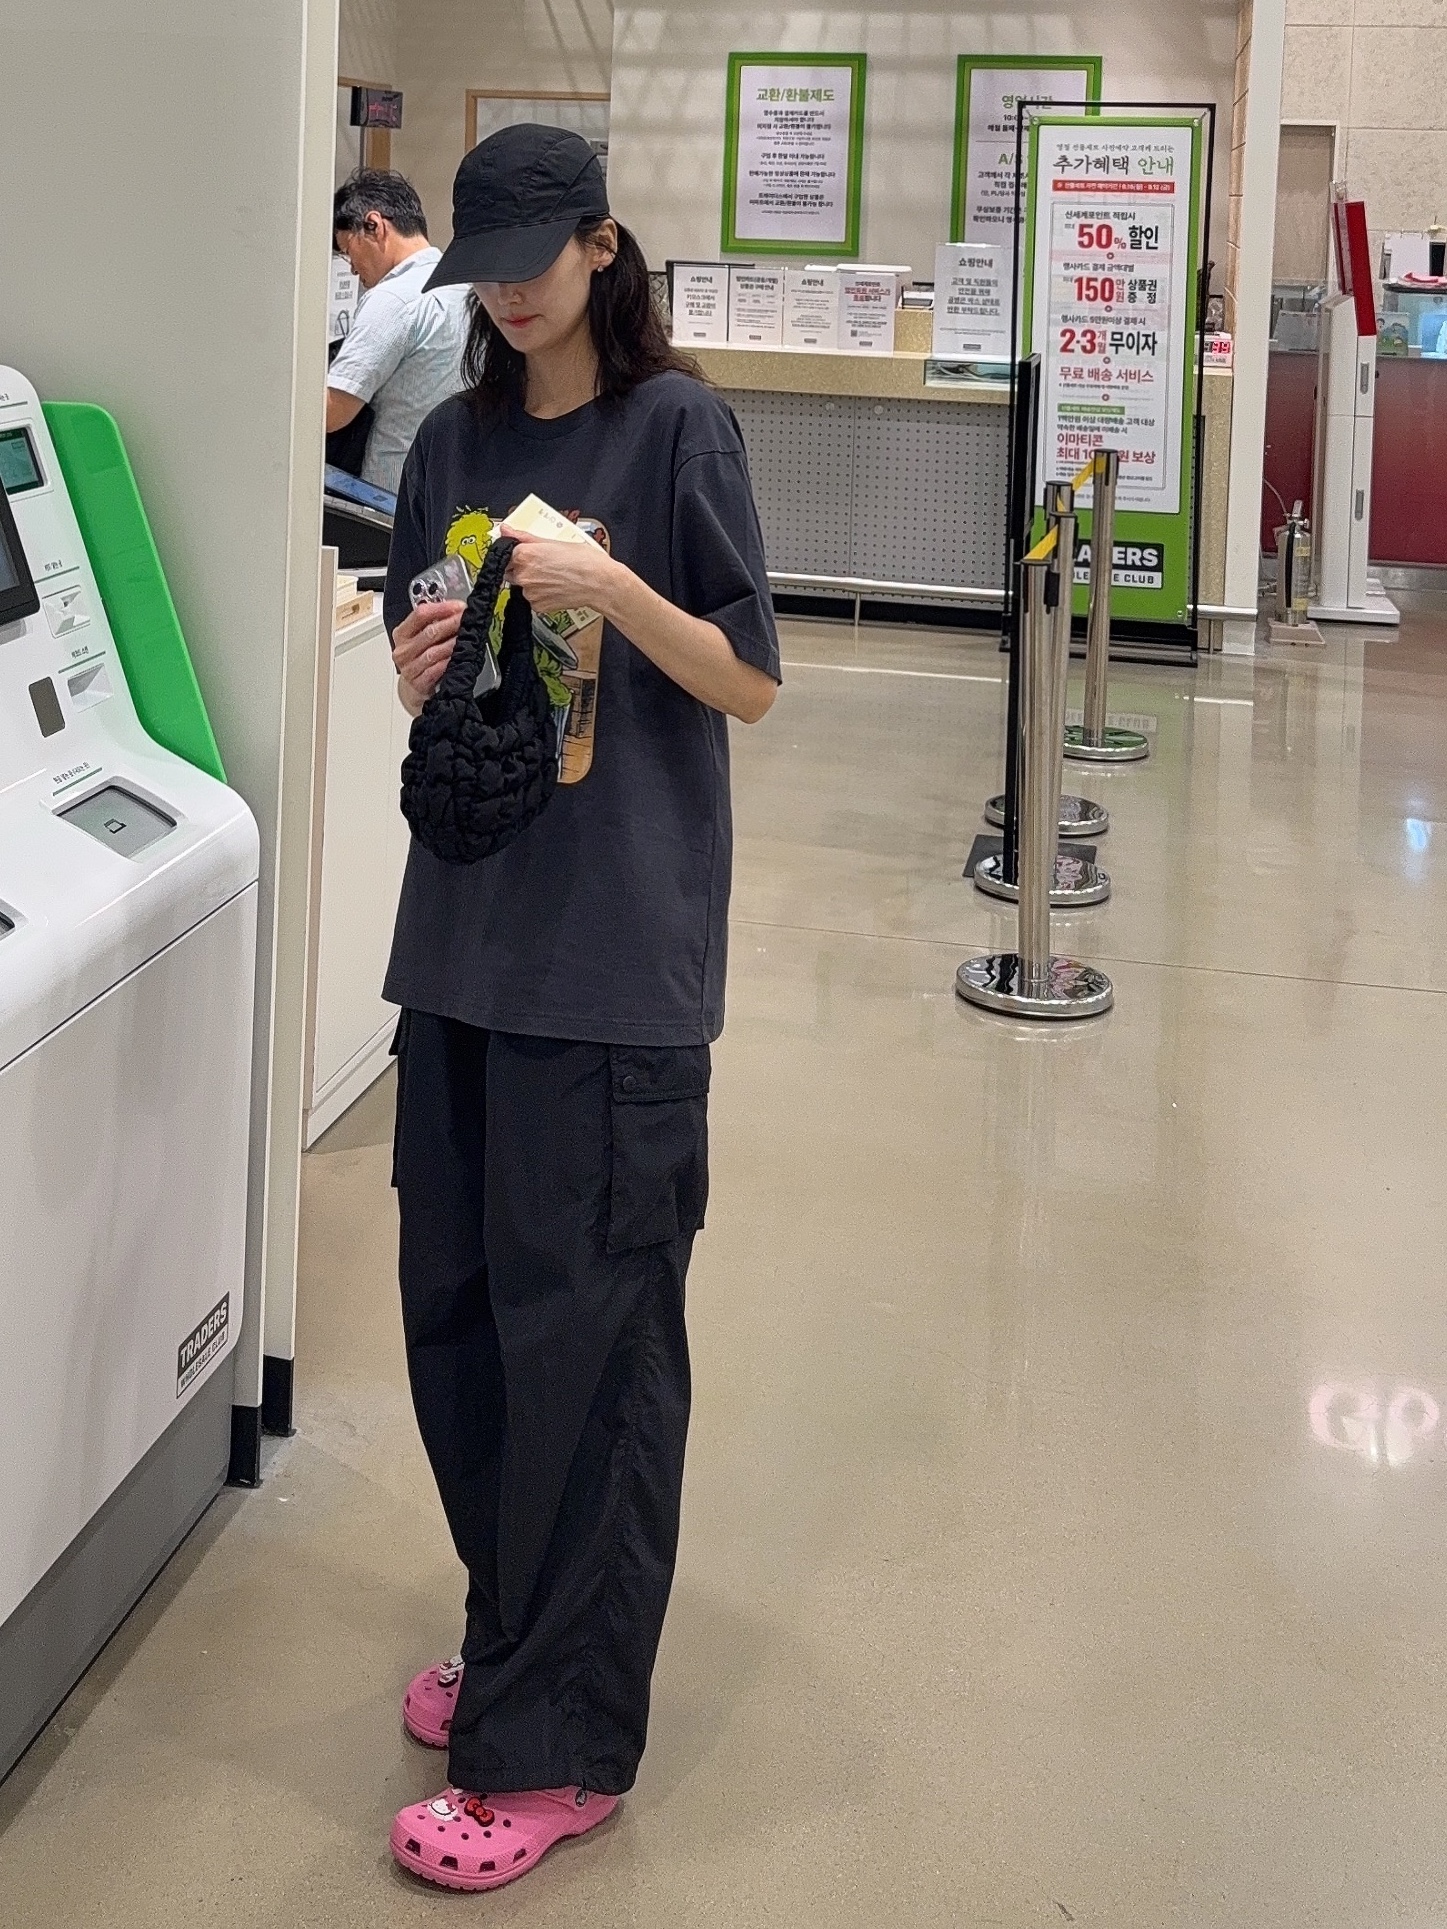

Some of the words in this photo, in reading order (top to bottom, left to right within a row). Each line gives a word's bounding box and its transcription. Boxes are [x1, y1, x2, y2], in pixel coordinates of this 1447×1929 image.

[756, 88, 835, 102] 교환/환불제도
[1052, 155, 1129, 175] 추가혜택
[1137, 156, 1174, 176] 안내
[1064, 210, 1111, 220] 신세계포인트
[1112, 211, 1136, 220] 적립시
[1078, 223, 1126, 250] 50%
[1128, 225, 1159, 250] 할인
[958, 258, 993, 268] 쇼핑안내
[1063, 263, 1091, 272] 행사카드
[1092, 263, 1105, 272] 결제
[1127, 279, 1158, 291] 상품권
[1061, 314, 1089, 324] 행사카드
[1090, 315, 1122, 325] 5만원이상
[1123, 317, 1137, 326] 결제
[1138, 317, 1146, 326] 시
[1109, 331, 1158, 356] 무이자
[1059, 366, 1084, 380] 무료
[1087, 367, 1112, 382] 배송
[1116, 368, 1154, 383] 서비스
[1126, 417, 1140, 426] 고객
[1141, 418, 1155, 427] 대상
[1057, 433, 1103, 447] 이마티콘
[1056, 448, 1080, 460] 최대
[1132, 451, 1156, 464] 보상
[1124, 574, 1154, 584] CLUB
[180, 1301, 228, 1368] TRADERS
